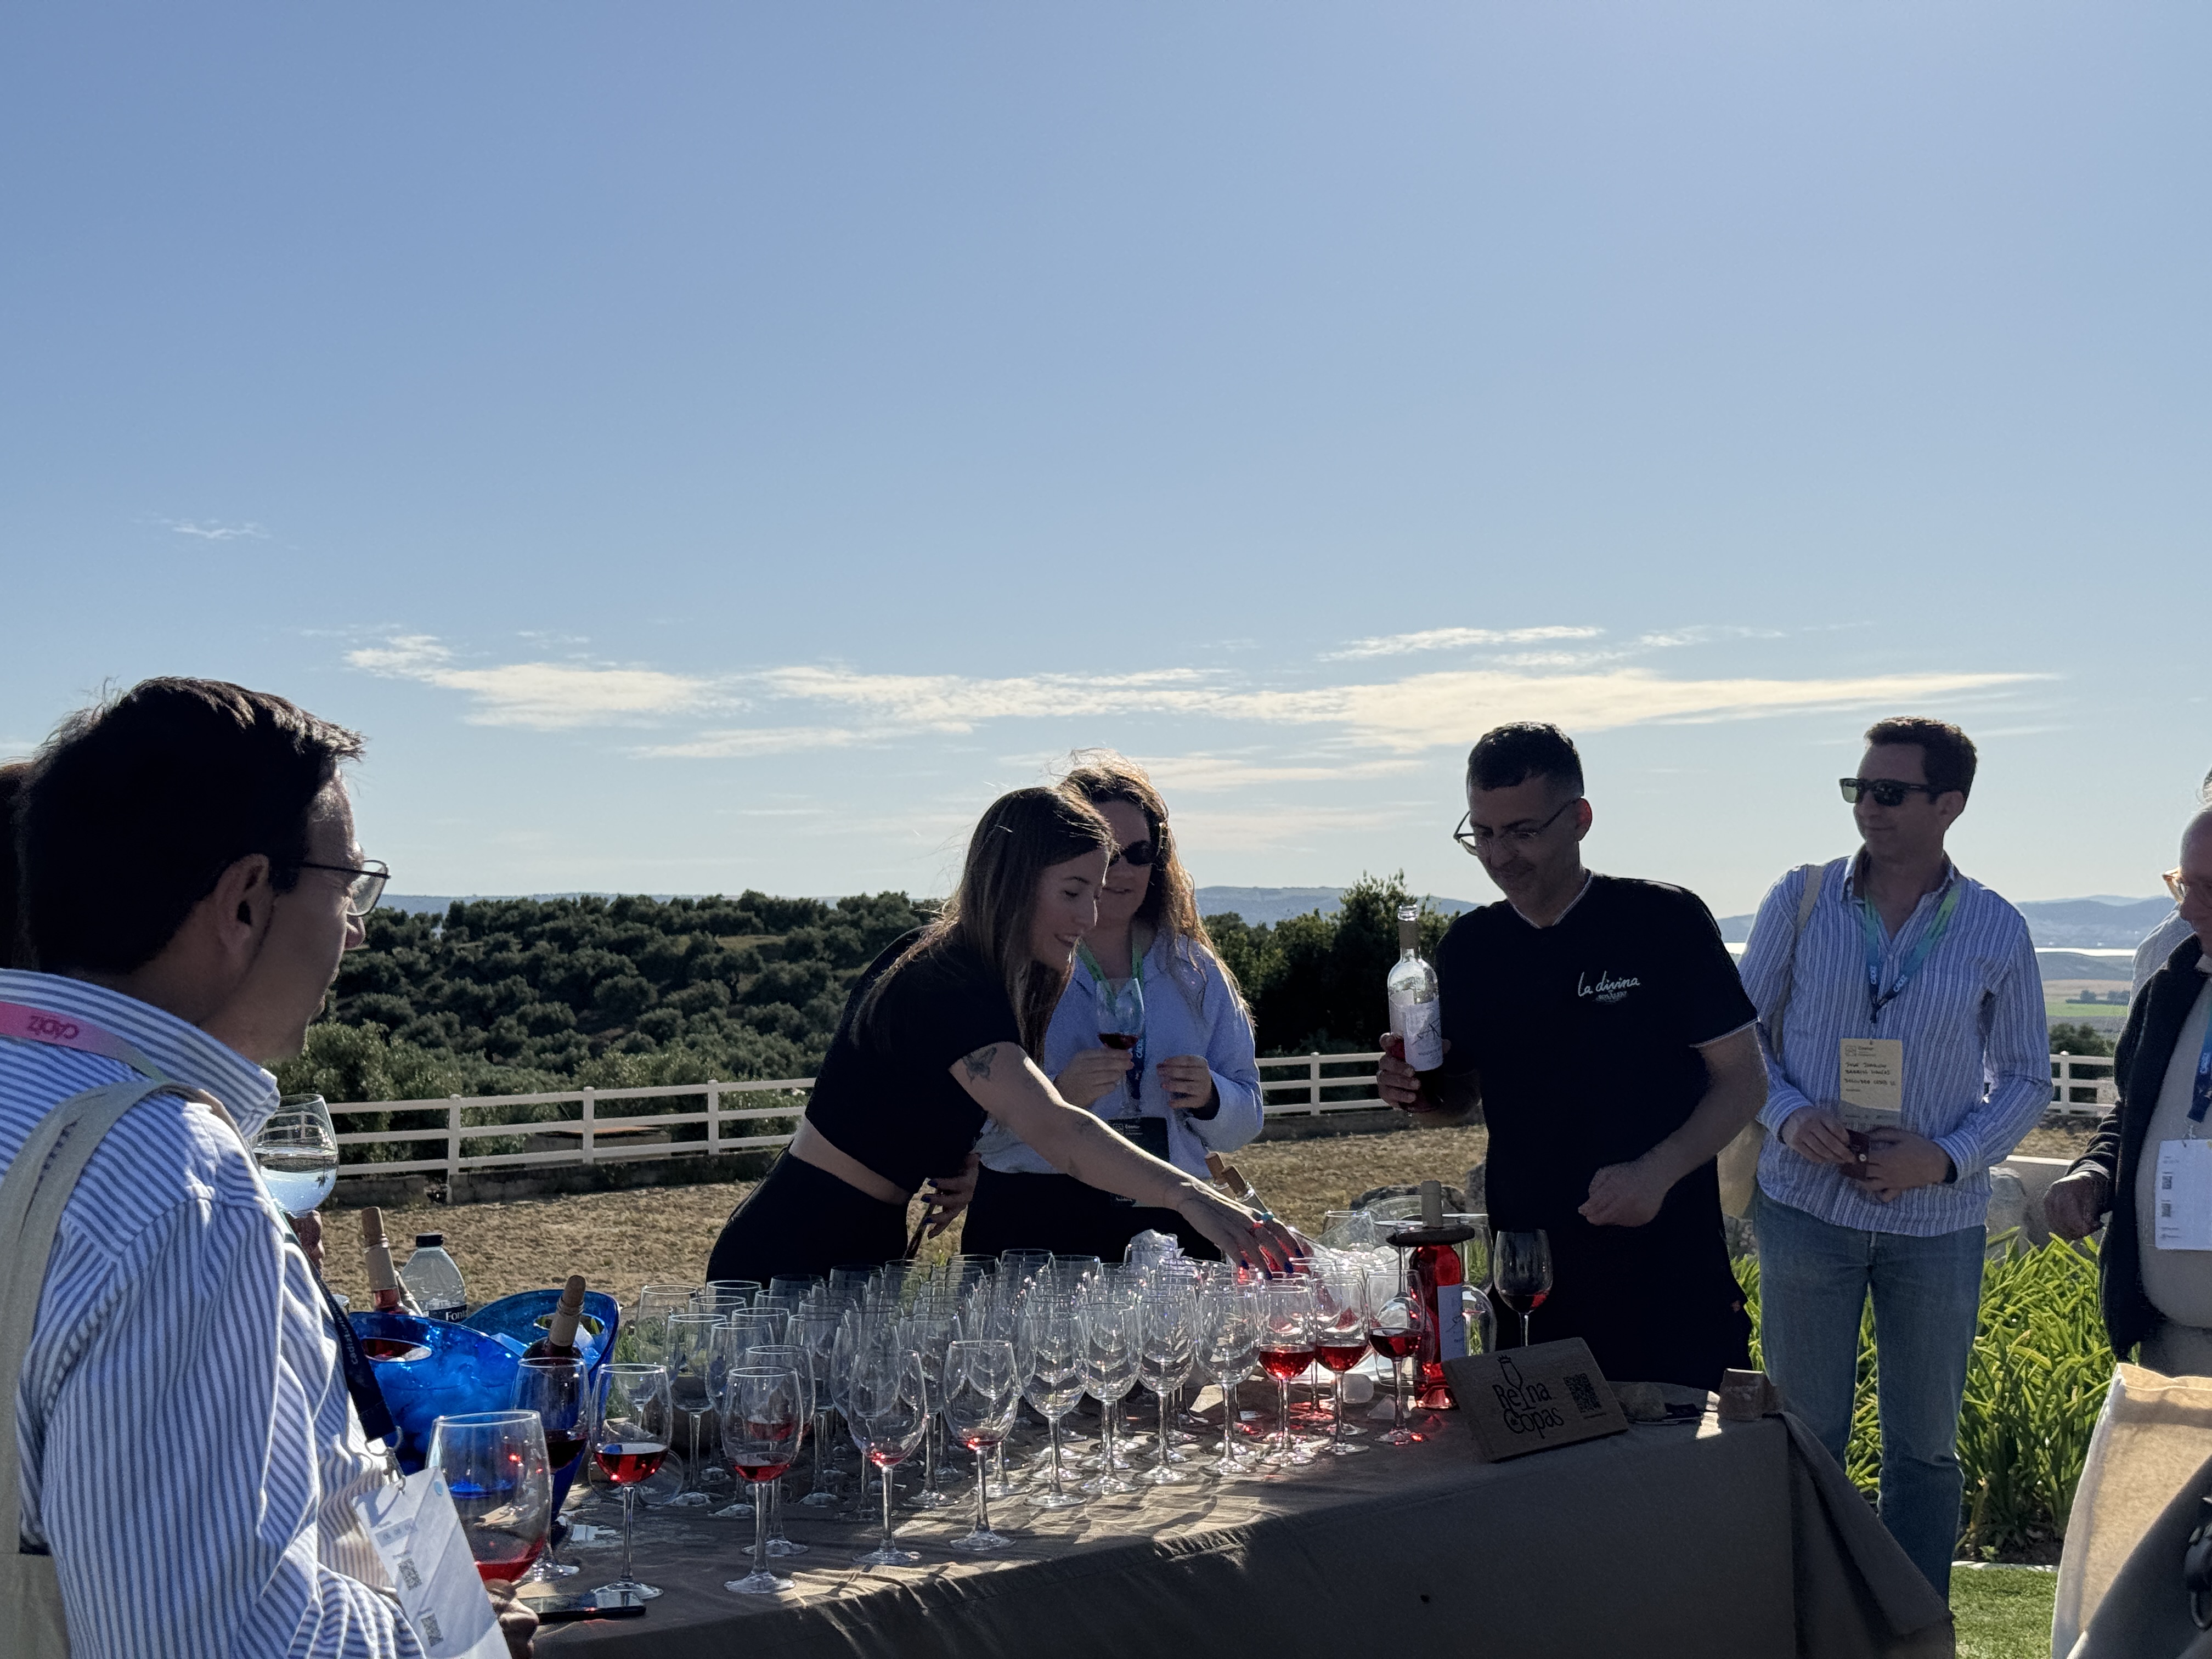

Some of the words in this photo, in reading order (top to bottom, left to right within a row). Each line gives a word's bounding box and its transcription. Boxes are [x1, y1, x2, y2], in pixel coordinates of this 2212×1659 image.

[1578, 972, 1593, 997] La
[1596, 970, 1641, 991] divina
[1503, 1407, 1564, 1440] Copas
